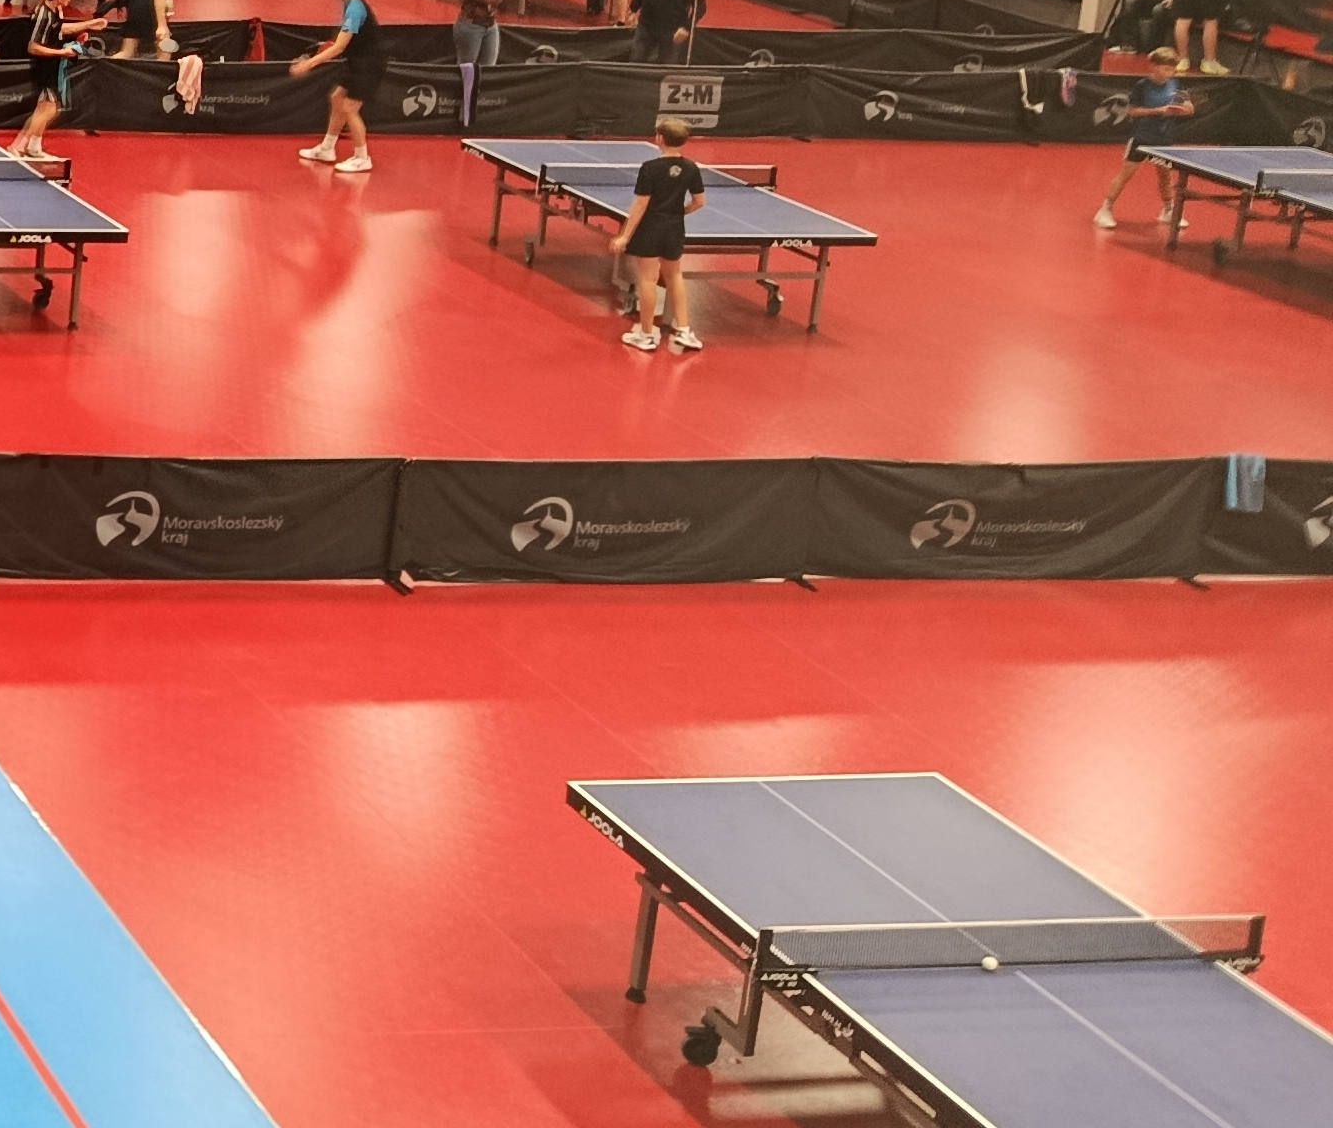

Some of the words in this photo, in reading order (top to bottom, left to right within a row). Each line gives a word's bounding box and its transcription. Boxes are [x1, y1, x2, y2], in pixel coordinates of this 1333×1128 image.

[667, 85, 713, 105] Z+M
[18, 235, 52, 243] JOOLA
[781, 238, 813, 247] JOOLA
[162, 514, 284, 534] Moravskoslezský
[574, 517, 691, 538] Moravskoslezský
[976, 517, 1088, 536] Moravskoslezský
[161, 528, 190, 547] kraj
[573, 533, 601, 551] kraj
[970, 532, 999, 549] kraj
[588, 812, 624, 849] JOOLA
